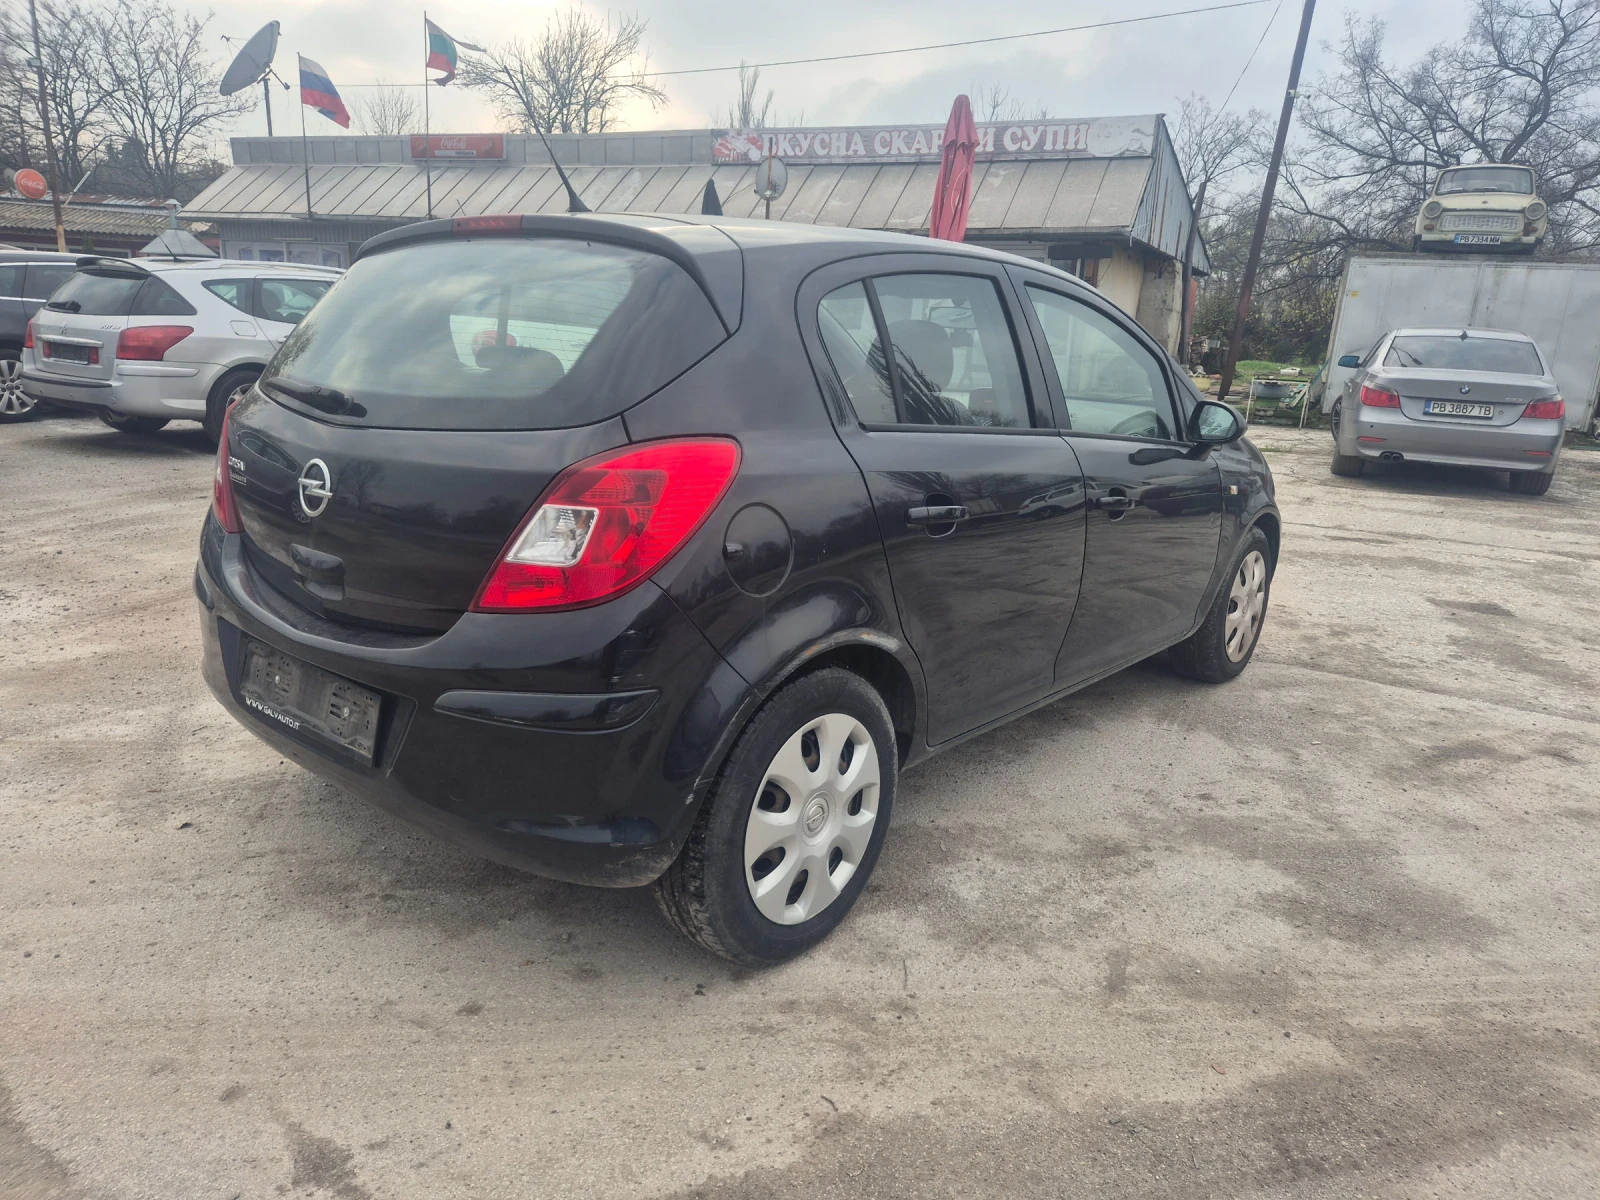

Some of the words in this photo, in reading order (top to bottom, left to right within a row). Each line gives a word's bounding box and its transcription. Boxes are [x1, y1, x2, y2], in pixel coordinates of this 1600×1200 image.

[761, 131, 867, 156] ВКУСНА
[873, 129, 948, 155] СКАР
[975, 127, 996, 152] И
[1003, 124, 1090, 152] СУПИ
[1432, 402, 1446, 413] PB
[1448, 403, 1476, 415] 3887
[1477, 405, 1492, 416] TB
